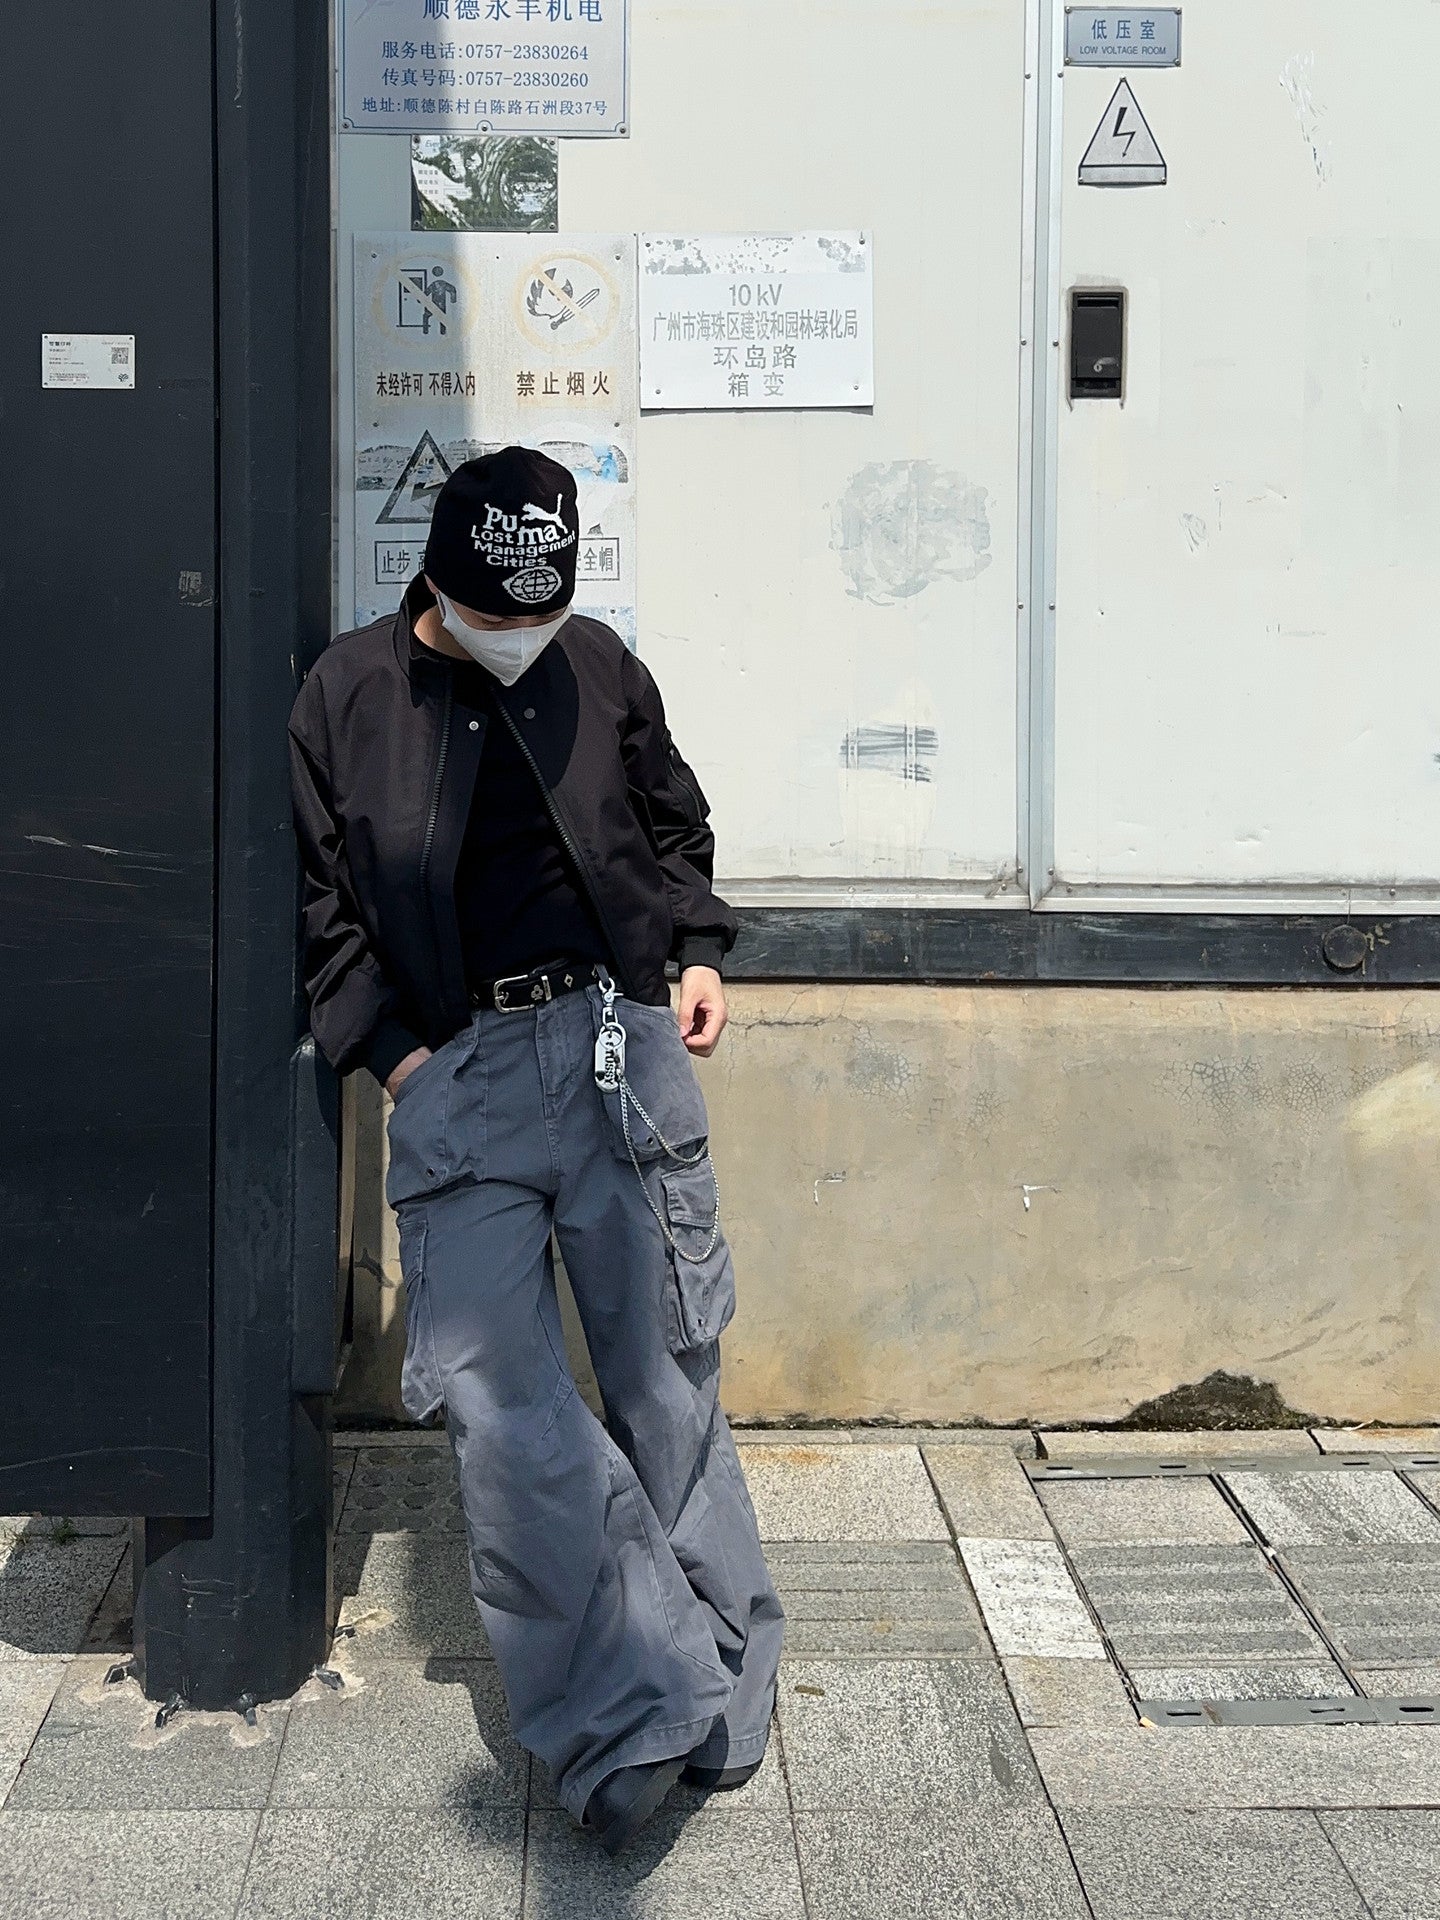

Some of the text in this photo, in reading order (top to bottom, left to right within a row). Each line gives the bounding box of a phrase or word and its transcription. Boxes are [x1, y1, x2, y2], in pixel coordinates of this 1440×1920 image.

[422, 0, 603, 22] 顺德永丰机电
[1091, 18, 1155, 40] 低压室
[1079, 46, 1166, 55] LOW VOLTAGE ROOM
[729, 284, 783, 306] 10 kV
[653, 309, 858, 341] 广州市海珠区建设和园林绿化局
[713, 344, 797, 369] 环岛路
[516, 371, 611, 396] 禁止烟火
[728, 372, 785, 397] 箱变
[471, 525, 515, 544] Lost
[474, 530, 576, 557] Management
[486, 554, 548, 568] Cities
[577, 546, 614, 572] 全帽
